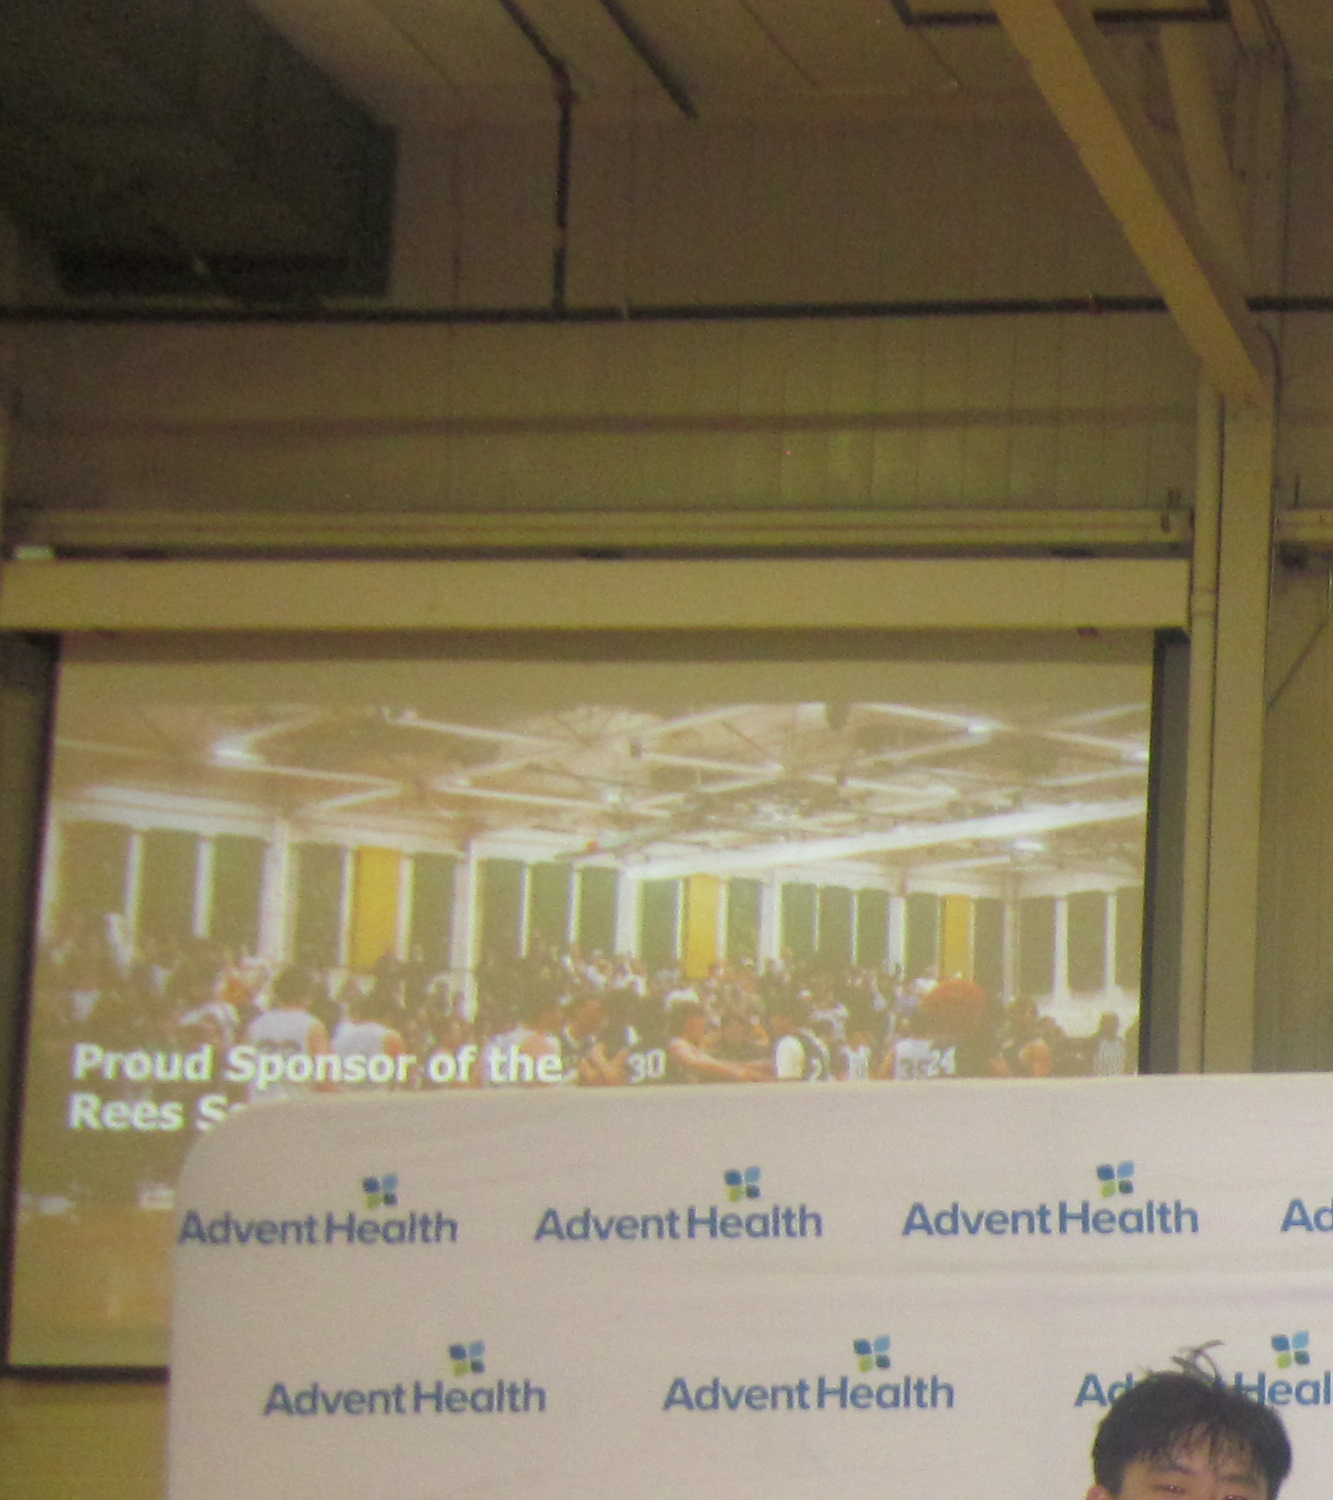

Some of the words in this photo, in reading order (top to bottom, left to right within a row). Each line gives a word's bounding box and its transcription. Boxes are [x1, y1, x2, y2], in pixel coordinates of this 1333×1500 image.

[72, 1042, 214, 1081] Proud
[224, 1045, 416, 1091] Sponsor
[427, 1044, 479, 1082] of
[488, 1044, 566, 1083] the
[68, 1092, 185, 1131] Rees
[180, 1209, 459, 1246] AdventHealth
[533, 1202, 824, 1242] AdventHealth
[901, 1198, 1200, 1238] AdventHealth
[265, 1379, 547, 1417] AdventHealth
[663, 1372, 957, 1413] AdventHealth
